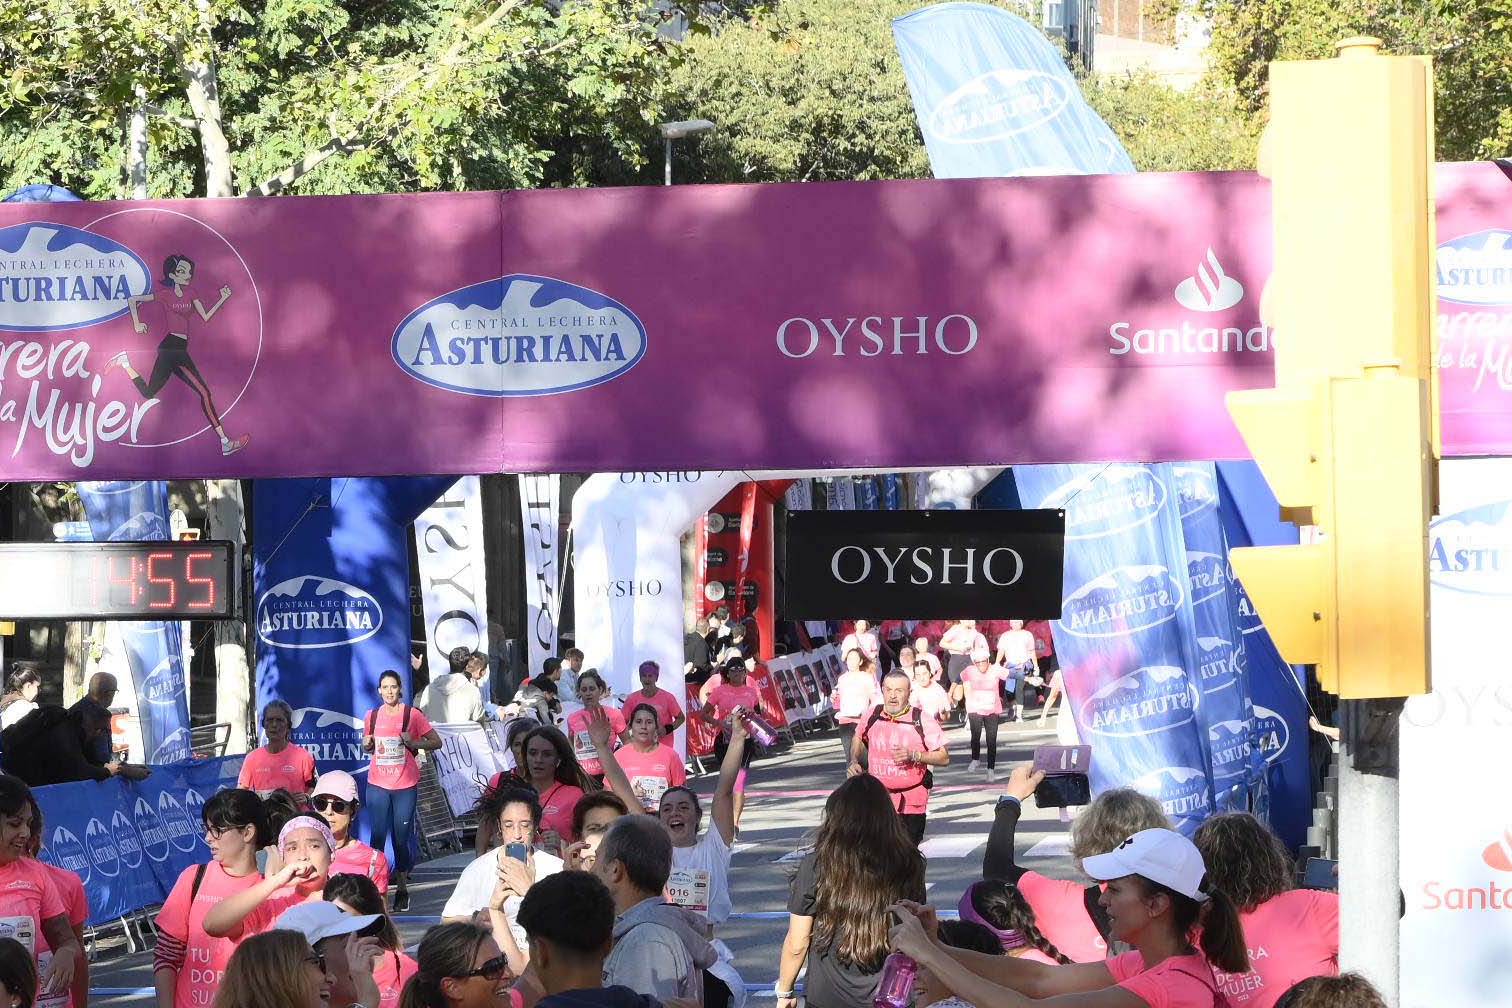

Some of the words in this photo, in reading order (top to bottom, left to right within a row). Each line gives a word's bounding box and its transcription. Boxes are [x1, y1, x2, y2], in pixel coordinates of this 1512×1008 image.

[54, 259, 126, 270] LECHERA
[450, 317, 530, 330] CENTRAL
[537, 313, 619, 328] LECHERA
[411, 320, 628, 368] ASTURIANA
[776, 314, 979, 359] OYSHO
[11, 374, 161, 468] Mujer
[830, 545, 1024, 587] OYSHO
[273, 600, 318, 610] CENTRAL
[319, 599, 369, 609] LECHERA
[260, 606, 373, 634] ASTURIANA
[873, 765, 908, 777] SUMA
[669, 887, 689, 897] 016
[191, 948, 210, 963] TU
